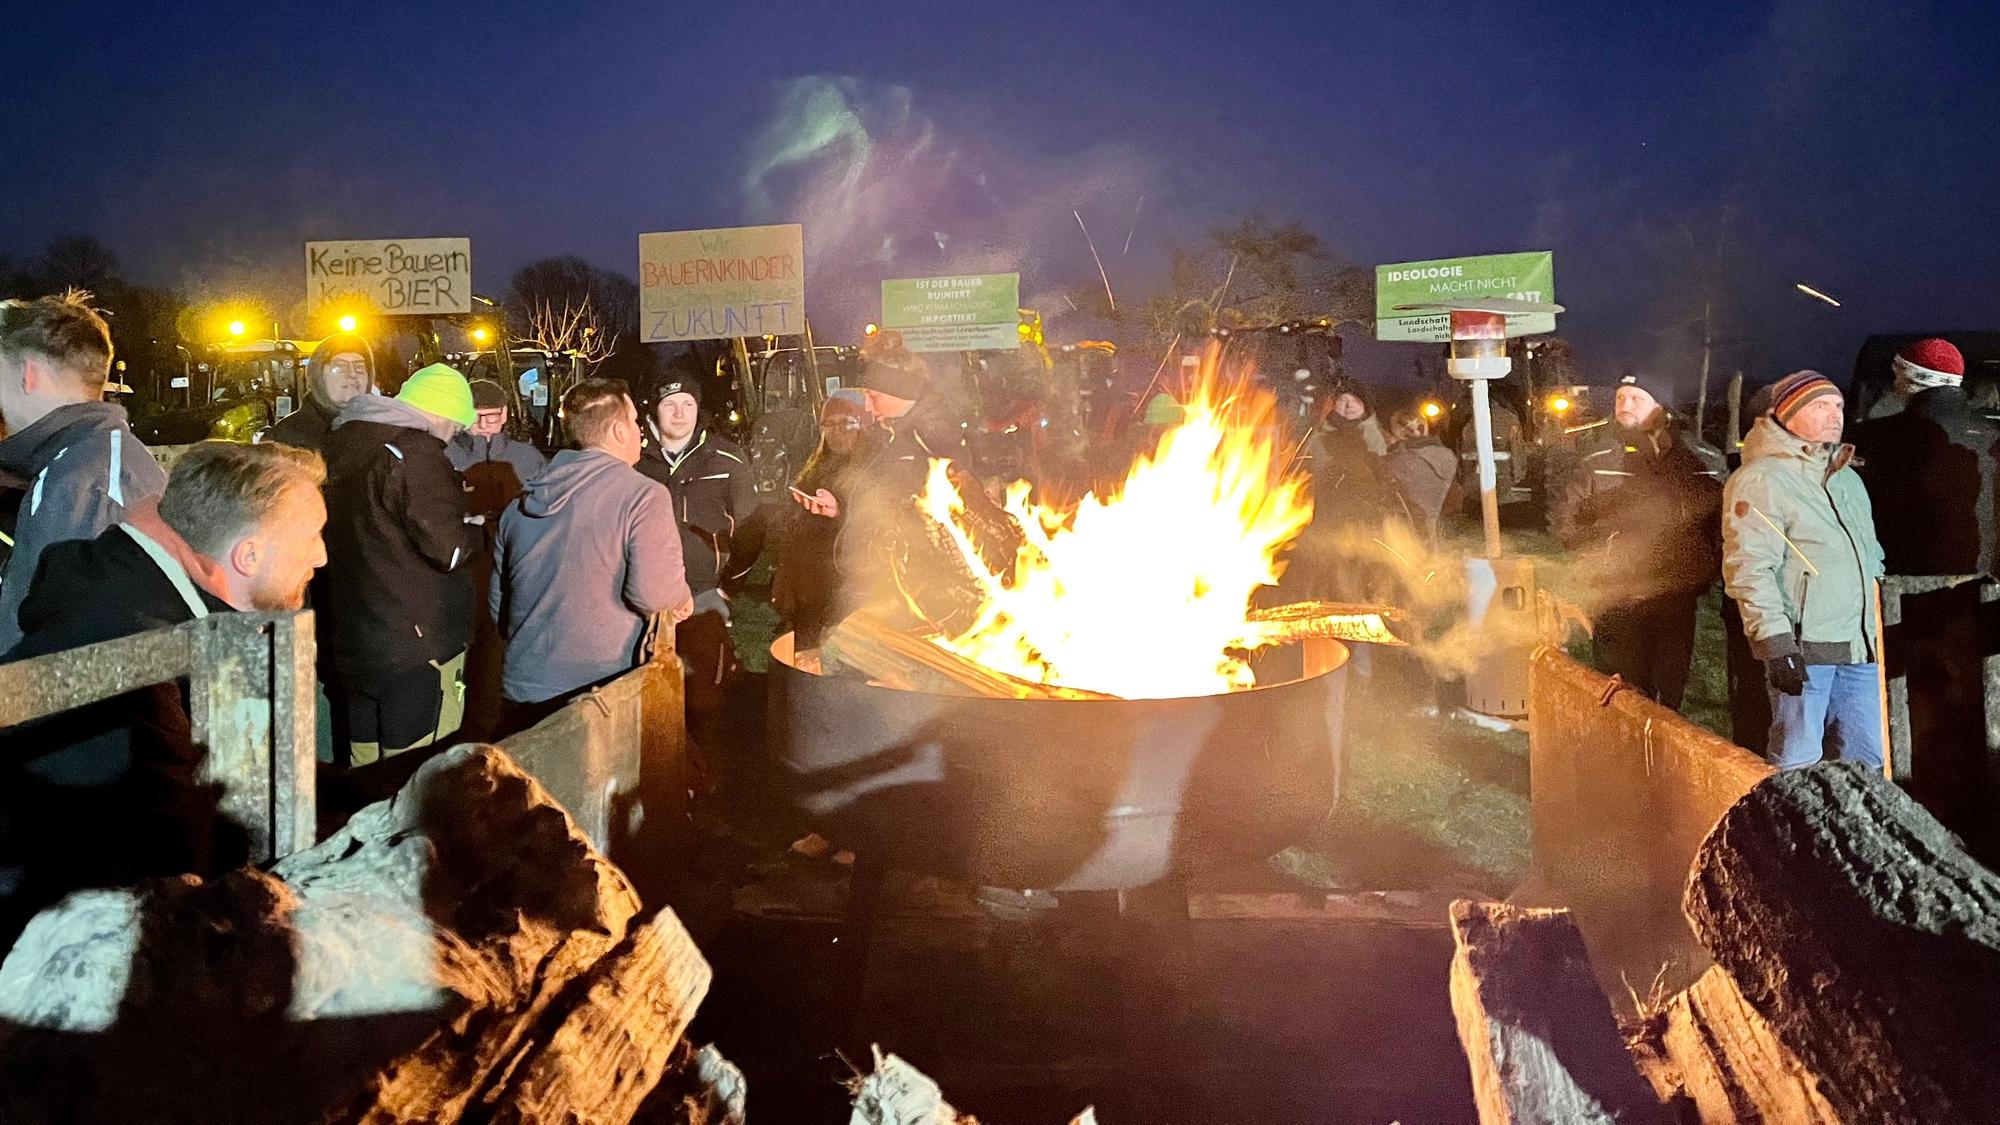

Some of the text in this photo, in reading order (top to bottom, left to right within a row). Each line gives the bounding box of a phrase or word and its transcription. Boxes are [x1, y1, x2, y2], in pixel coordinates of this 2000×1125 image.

[310, 243, 469, 277] Keine Bauern
[642, 255, 797, 288] BAUERNKINDER
[1387, 265, 1463, 282] IDEOLOGIE
[380, 275, 460, 309] BIER
[916, 277, 982, 289] IST DER BAUER
[1429, 276, 1518, 294] MACHT NICHT
[927, 289, 971, 300] RUINIERT
[649, 301, 795, 340] ZUKUNFT
[921, 312, 976, 324] IMPORTIERT
